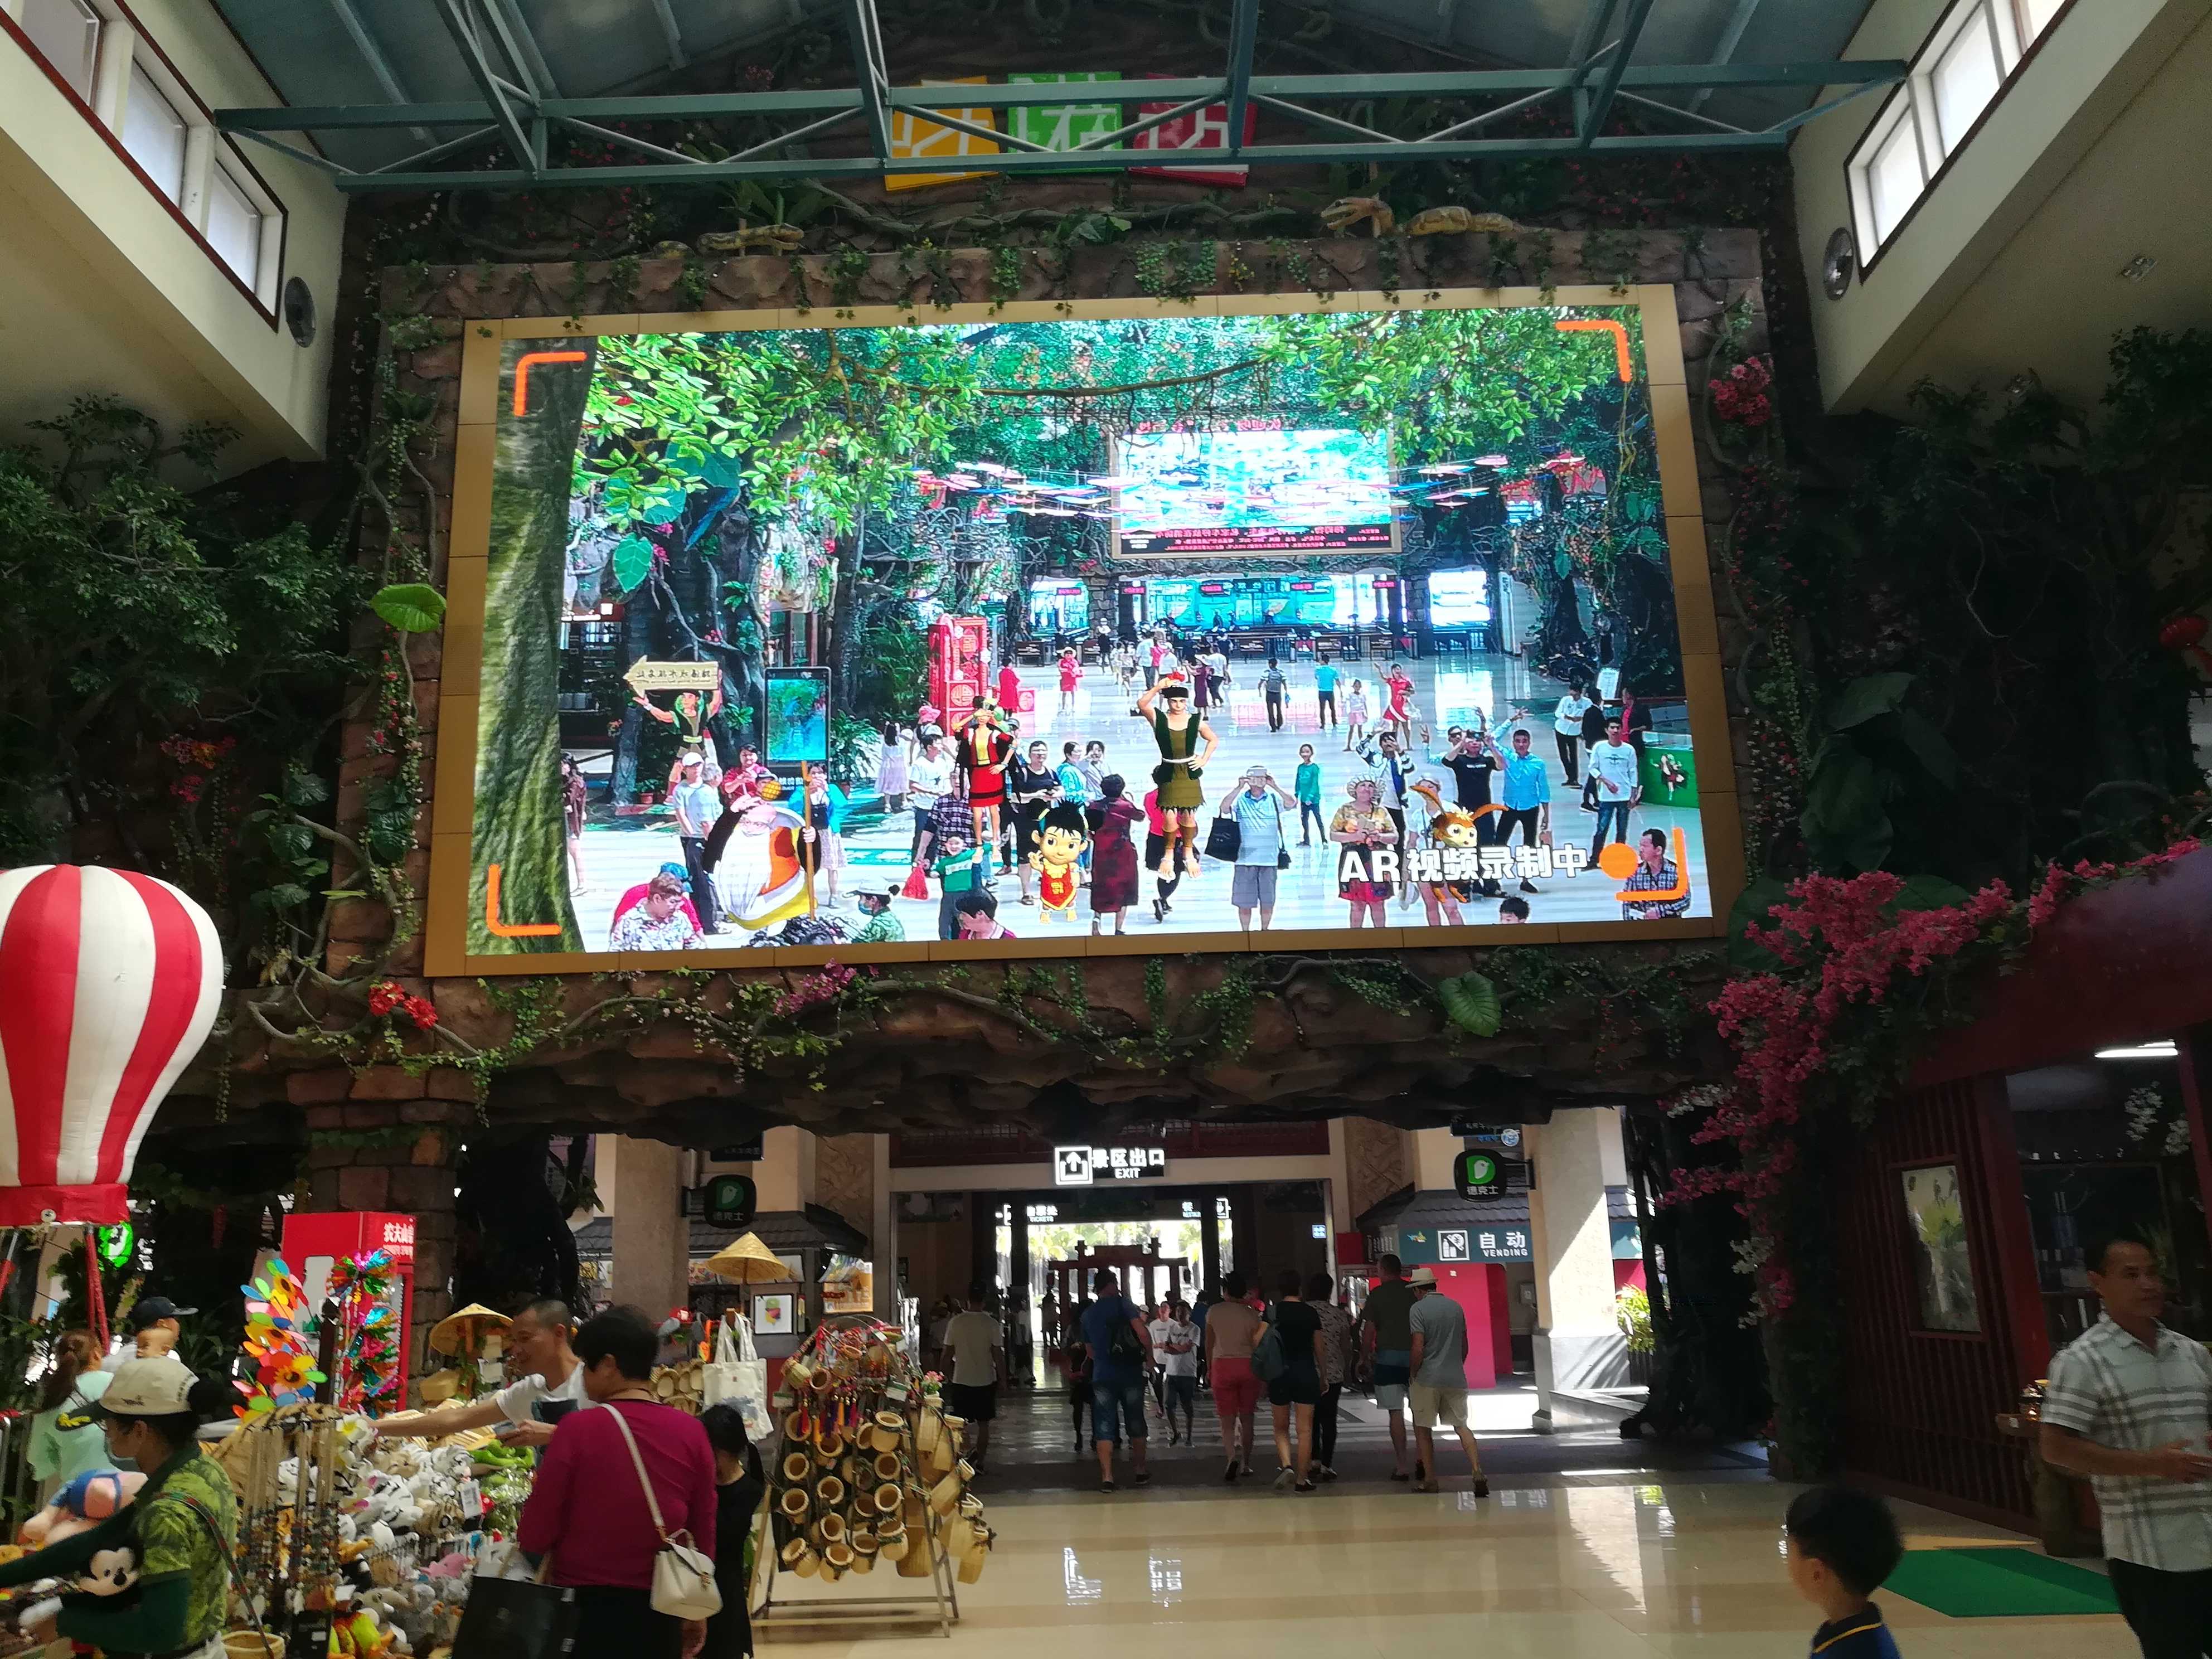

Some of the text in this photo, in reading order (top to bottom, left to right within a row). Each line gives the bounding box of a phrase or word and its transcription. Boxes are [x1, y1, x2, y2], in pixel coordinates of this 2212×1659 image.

[1093, 1147, 1165, 1168] 景区出口
[1115, 1167, 1141, 1179] EXIT
[1479, 1231, 1526, 1249] 自动
[1482, 1248, 1529, 1258] VENDING
